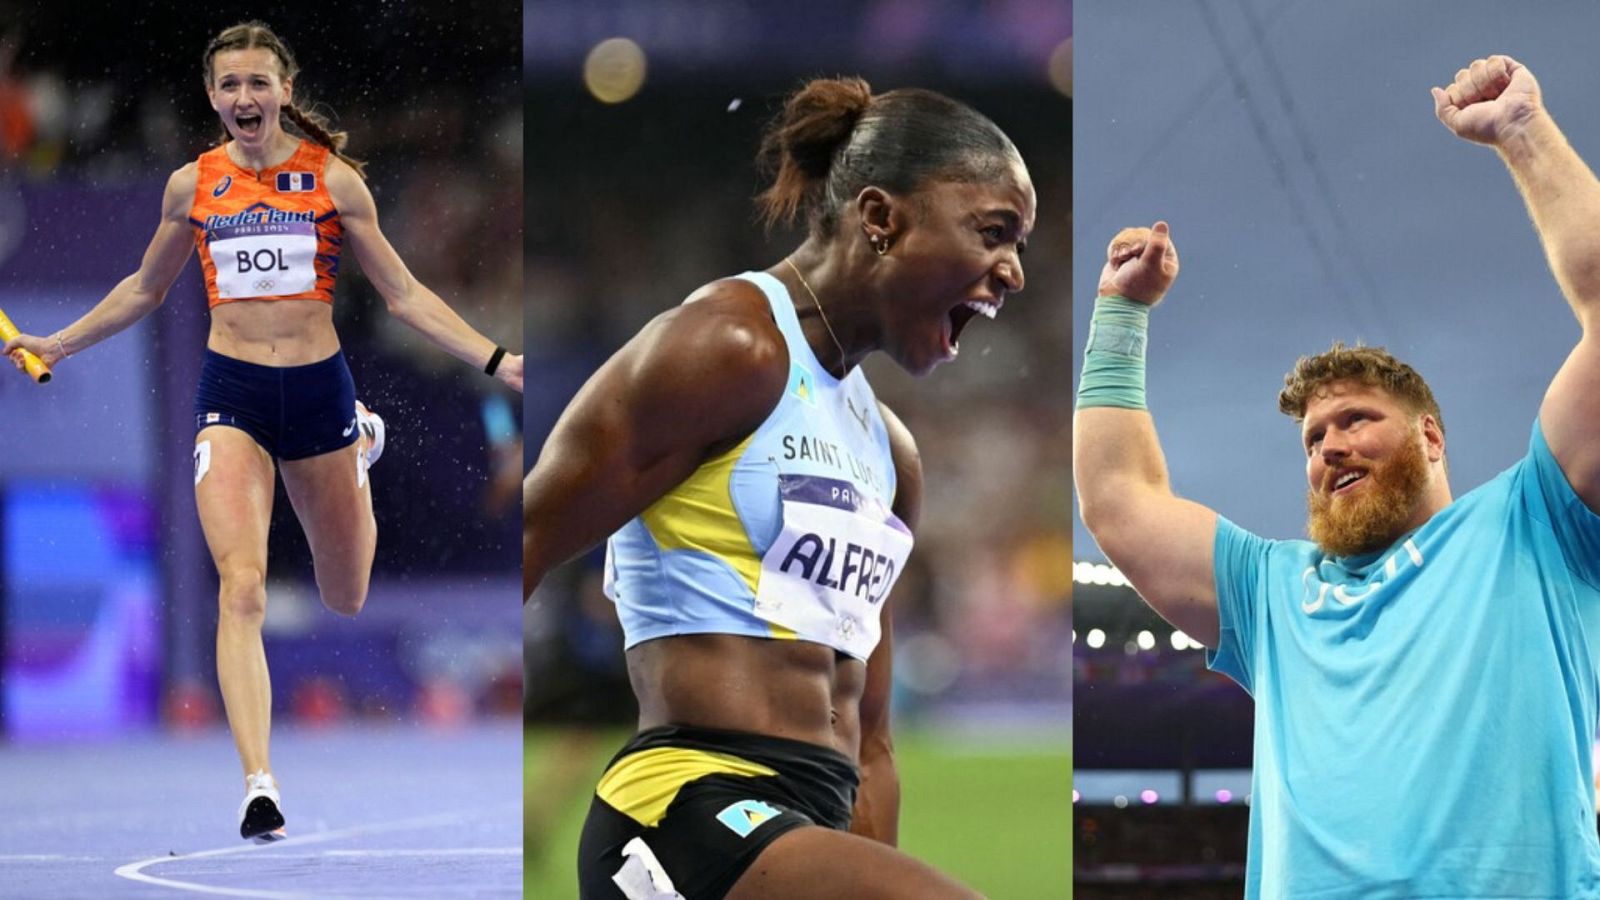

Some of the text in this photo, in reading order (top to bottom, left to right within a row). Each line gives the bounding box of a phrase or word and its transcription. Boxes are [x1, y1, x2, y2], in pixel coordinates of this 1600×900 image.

[235, 225, 289, 234] PARIS 2024
[236, 248, 289, 273] BOL
[782, 434, 842, 469] SAINT
[780, 532, 896, 605] ALFRED
